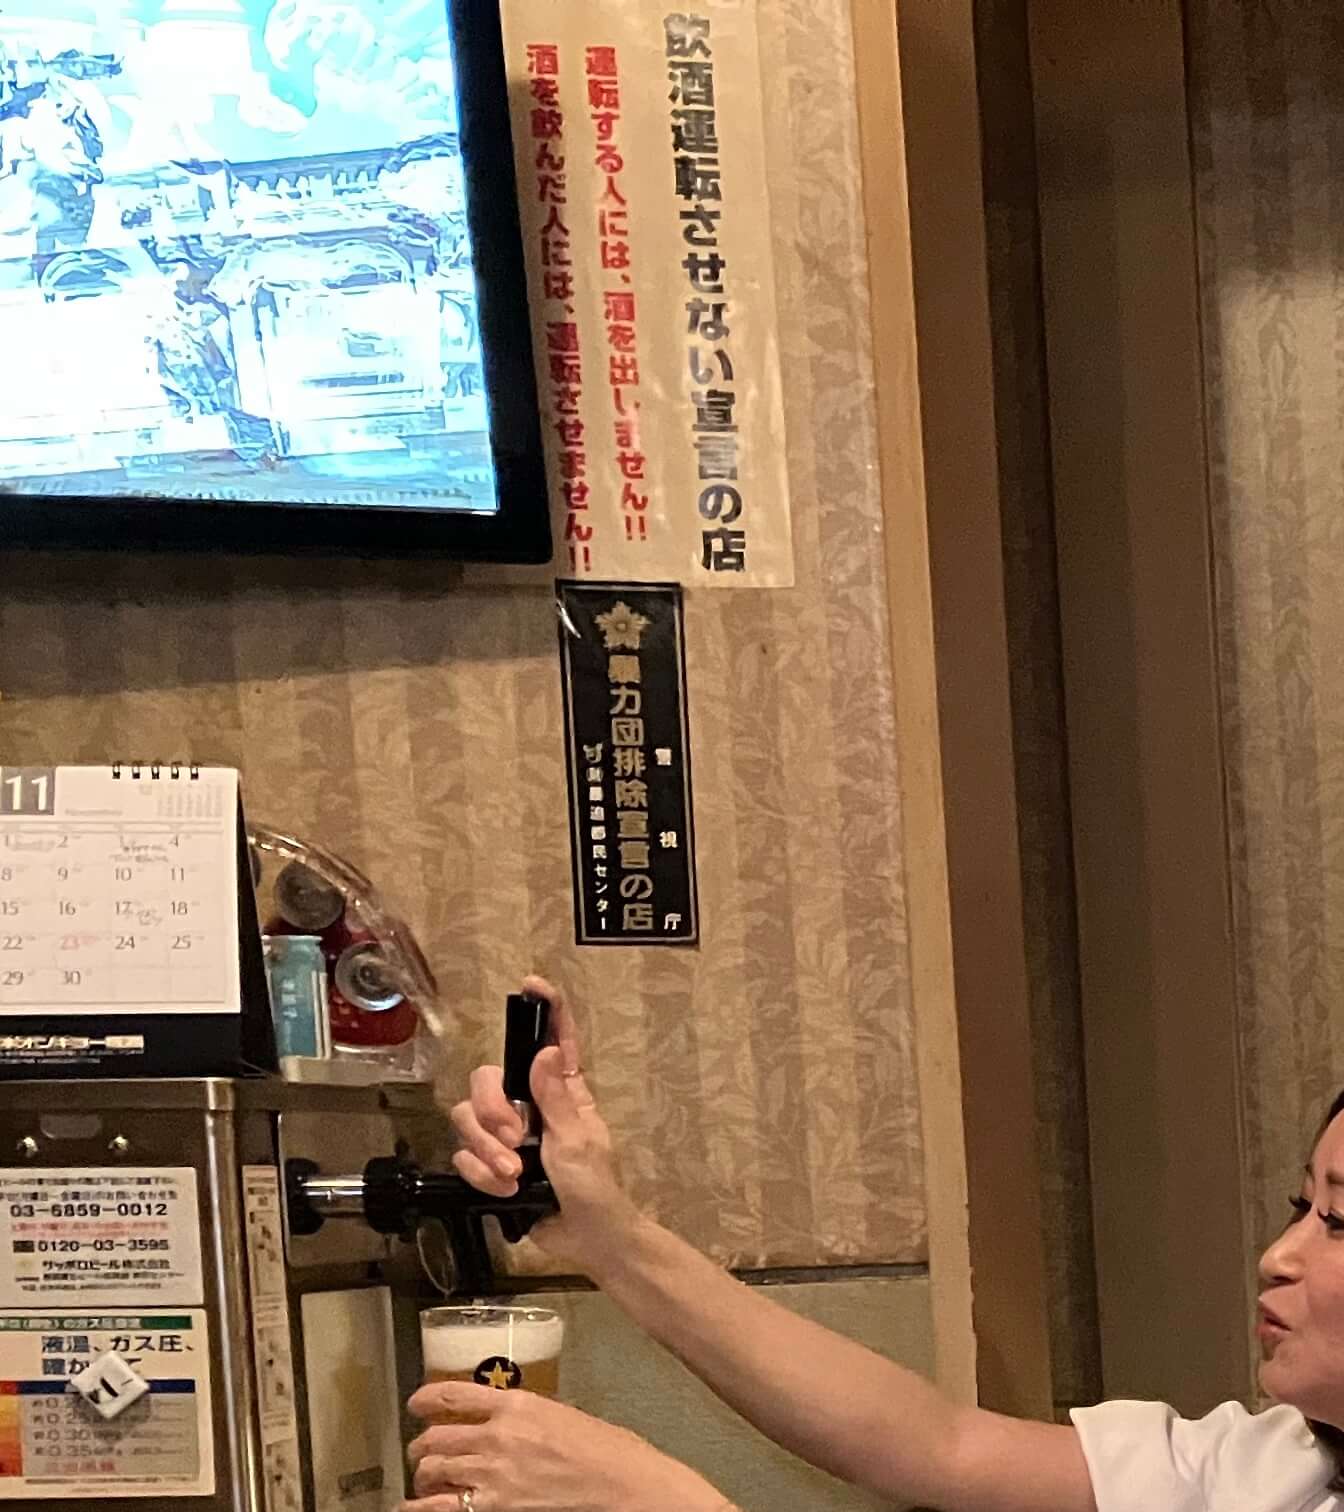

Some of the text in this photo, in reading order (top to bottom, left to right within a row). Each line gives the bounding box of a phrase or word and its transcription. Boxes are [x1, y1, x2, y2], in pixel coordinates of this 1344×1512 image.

[664, 13, 746, 573] 飲酒運転させない宣言の店
[5, 775, 48, 811] 11
[58, 868, 68, 880] 9
[115, 868, 131, 880] 10
[171, 868, 184, 880] 11
[59, 902, 76, 915] 16
[171, 902, 188, 915] 18
[2, 936, 23, 949] 22
[115, 936, 135, 949] 24
[171, 936, 191, 949] 25
[2, 971, 80, 985] 29 30
[10, 1203, 168, 1217] 03-6859-0012
